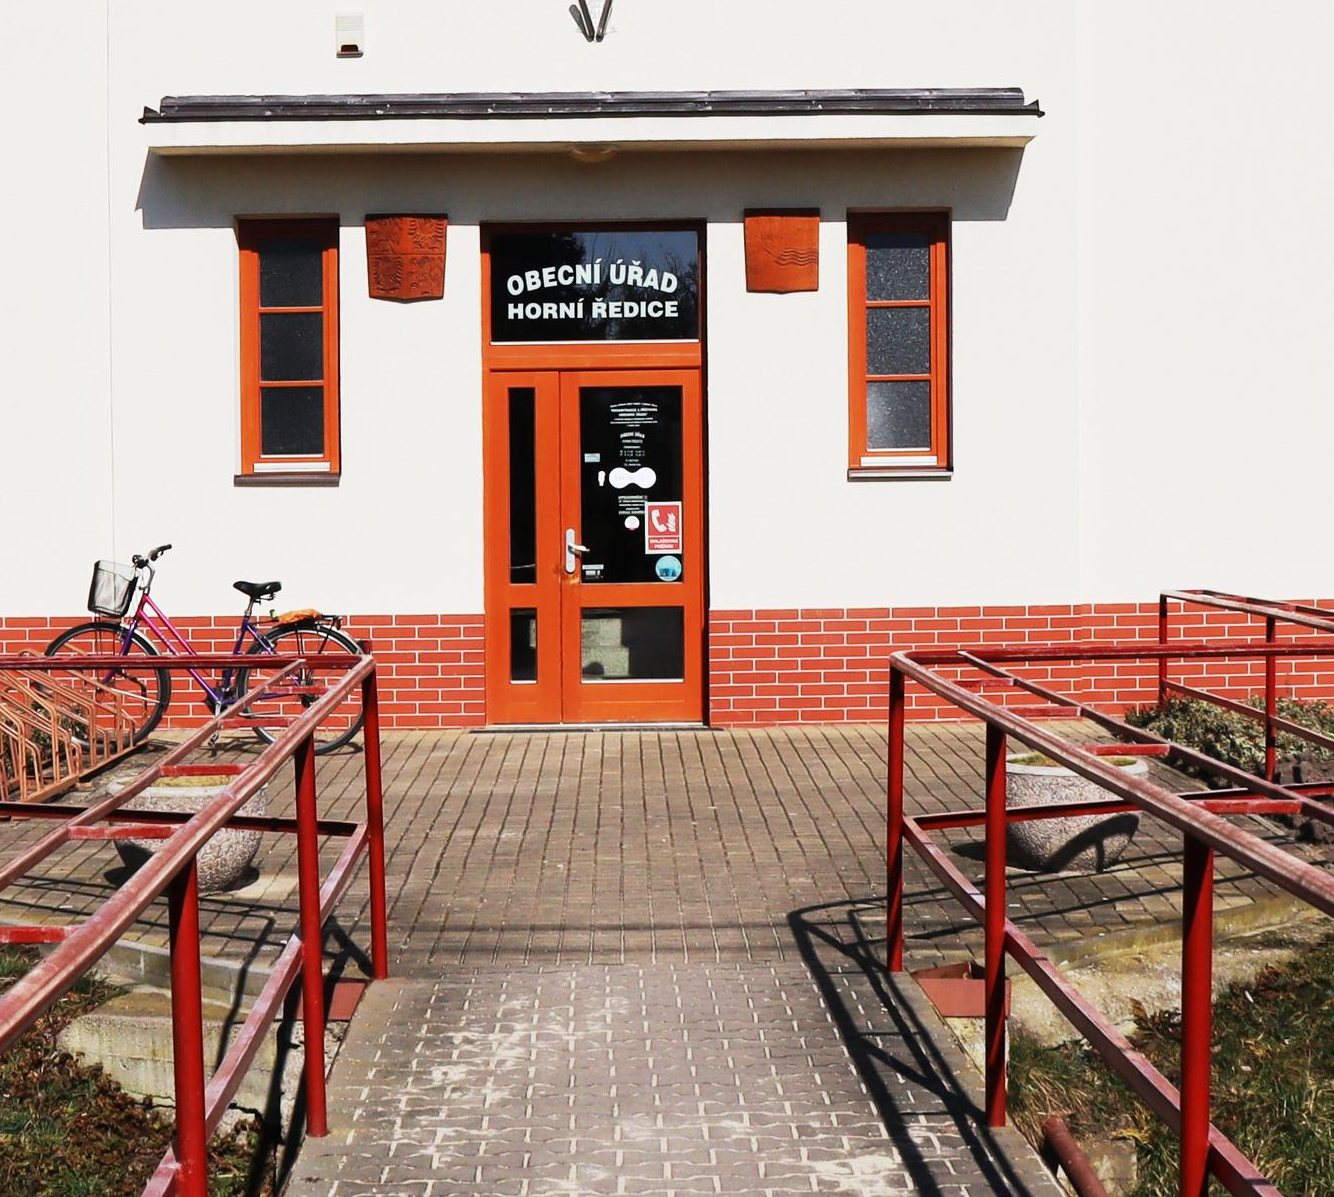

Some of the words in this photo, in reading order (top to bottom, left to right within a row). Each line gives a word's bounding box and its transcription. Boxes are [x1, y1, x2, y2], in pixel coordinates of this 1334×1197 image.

[507, 258, 602, 295] OBECNÍ
[610, 259, 677, 293] ÚŘAD
[508, 298, 584, 319] HORNÍ
[592, 298, 678, 318] ŘEDICE
